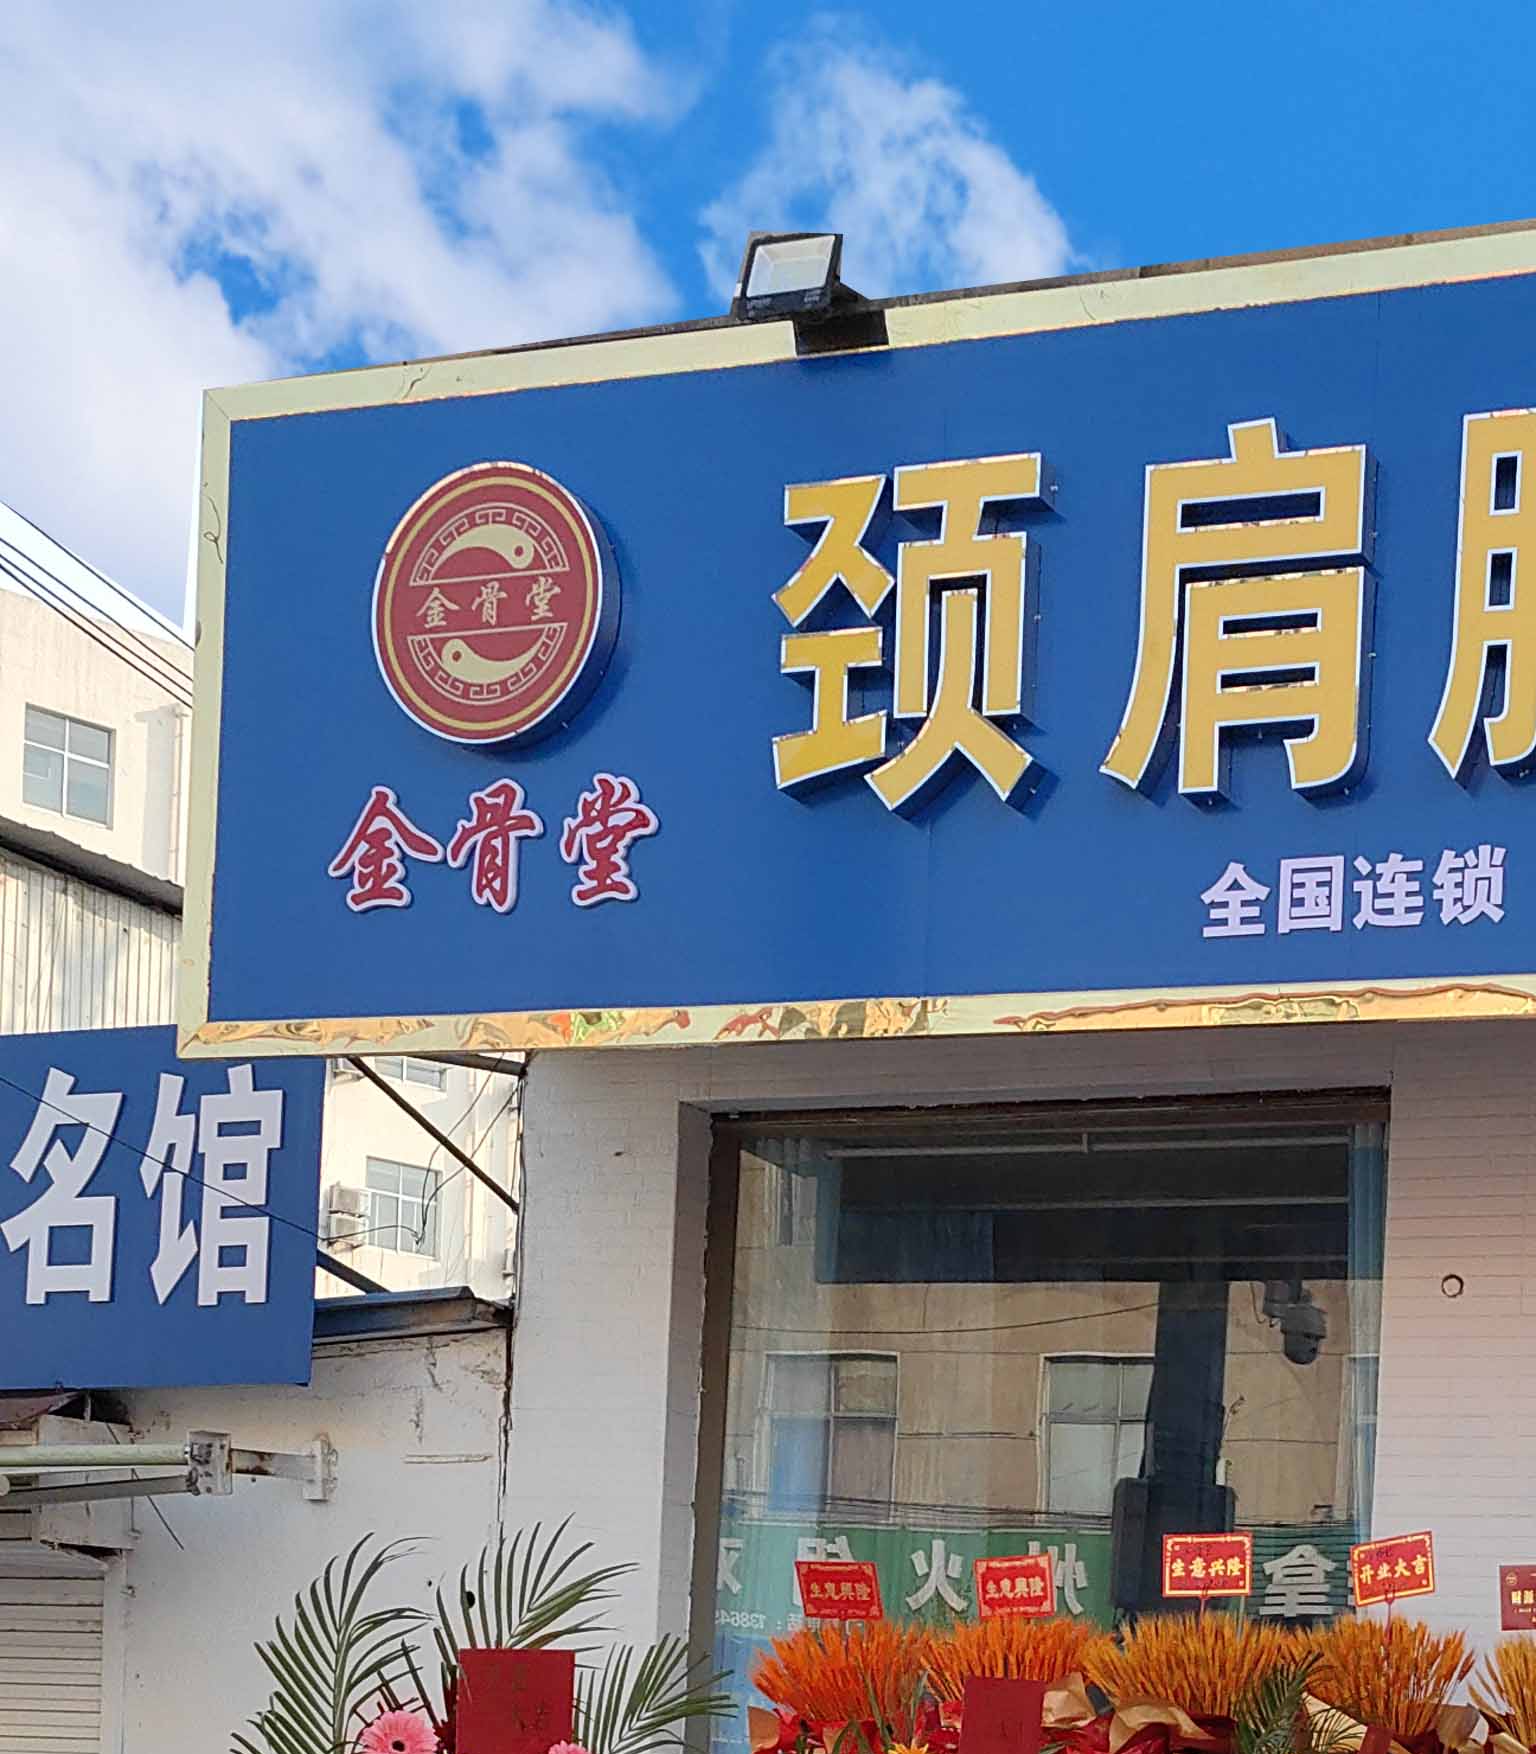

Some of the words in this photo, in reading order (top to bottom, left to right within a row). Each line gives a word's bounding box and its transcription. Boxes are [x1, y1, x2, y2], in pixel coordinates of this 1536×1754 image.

[416, 576, 562, 629] 金骨堂
[328, 773, 660, 914] 金骨堂
[1200, 843, 1508, 939] 全国连锁
[0, 1063, 284, 1307] 名馆
[1170, 1556, 1245, 1579] 生意兴隆
[1359, 1553, 1428, 1585] 开业大吉
